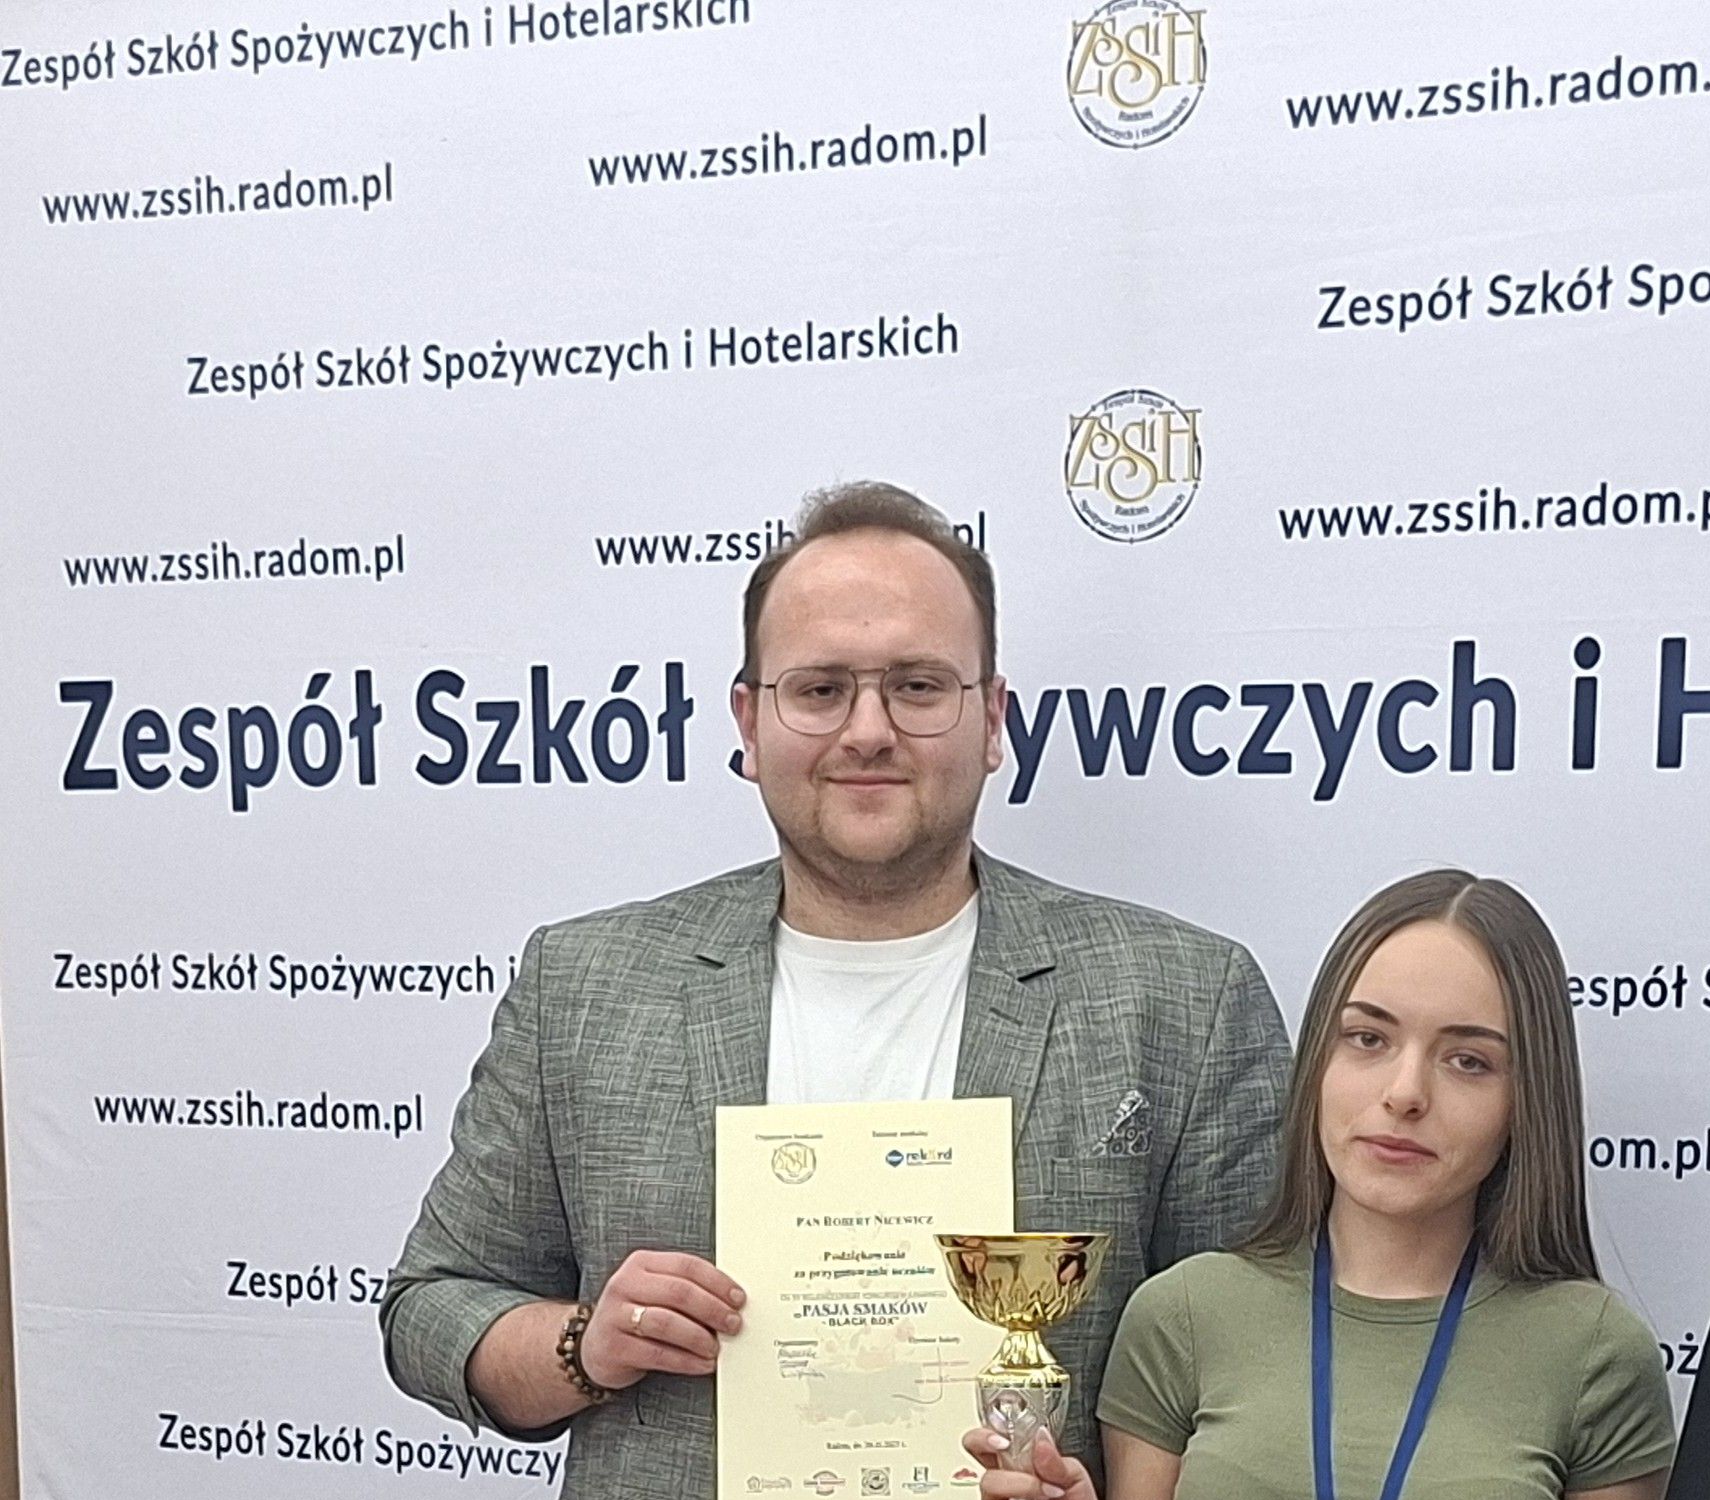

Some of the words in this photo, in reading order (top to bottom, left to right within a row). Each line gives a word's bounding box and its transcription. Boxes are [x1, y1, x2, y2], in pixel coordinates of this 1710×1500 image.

[1, 41, 116, 90] Zespół
[127, 31, 219, 77] Szkół
[230, 10, 469, 74] Spożywczych
[484, 7, 492, 47] i
[509, 0, 750, 45] Hotelarskich
[588, 114, 986, 186] www.zssih.radom.pl
[42, 162, 392, 224] www.zssih.radom.pl
[1318, 275, 1473, 333] Zespół
[1487, 265, 1613, 317] Szkół
[187, 350, 304, 399] Zespół
[316, 343, 410, 388] Szkół
[423, 330, 668, 388] Spożywczych
[684, 329, 692, 369] i
[709, 312, 958, 367] Hotelarskich
[64, 534, 404, 586] www.zssih.radom.pl
[59, 669, 382, 812] Zespół
[415, 661, 694, 785] Szkół
[1571, 636, 1601, 770] i
[53, 952, 161, 997] Zespół
[172, 953, 258, 991] Szkół
[269, 954, 494, 1001] Spożywczych
[1569, 964, 1688, 1017] espół
[94, 1090, 422, 1139] www.zssih.radom.pl
[227, 1261, 338, 1308] Zespół
[853, 1299, 928, 1316] SMAKÓW
[158, 1413, 266, 1460] Zespół
[277, 1422, 364, 1463] Szkół
[375, 1429, 562, 1486] Spożywczy
